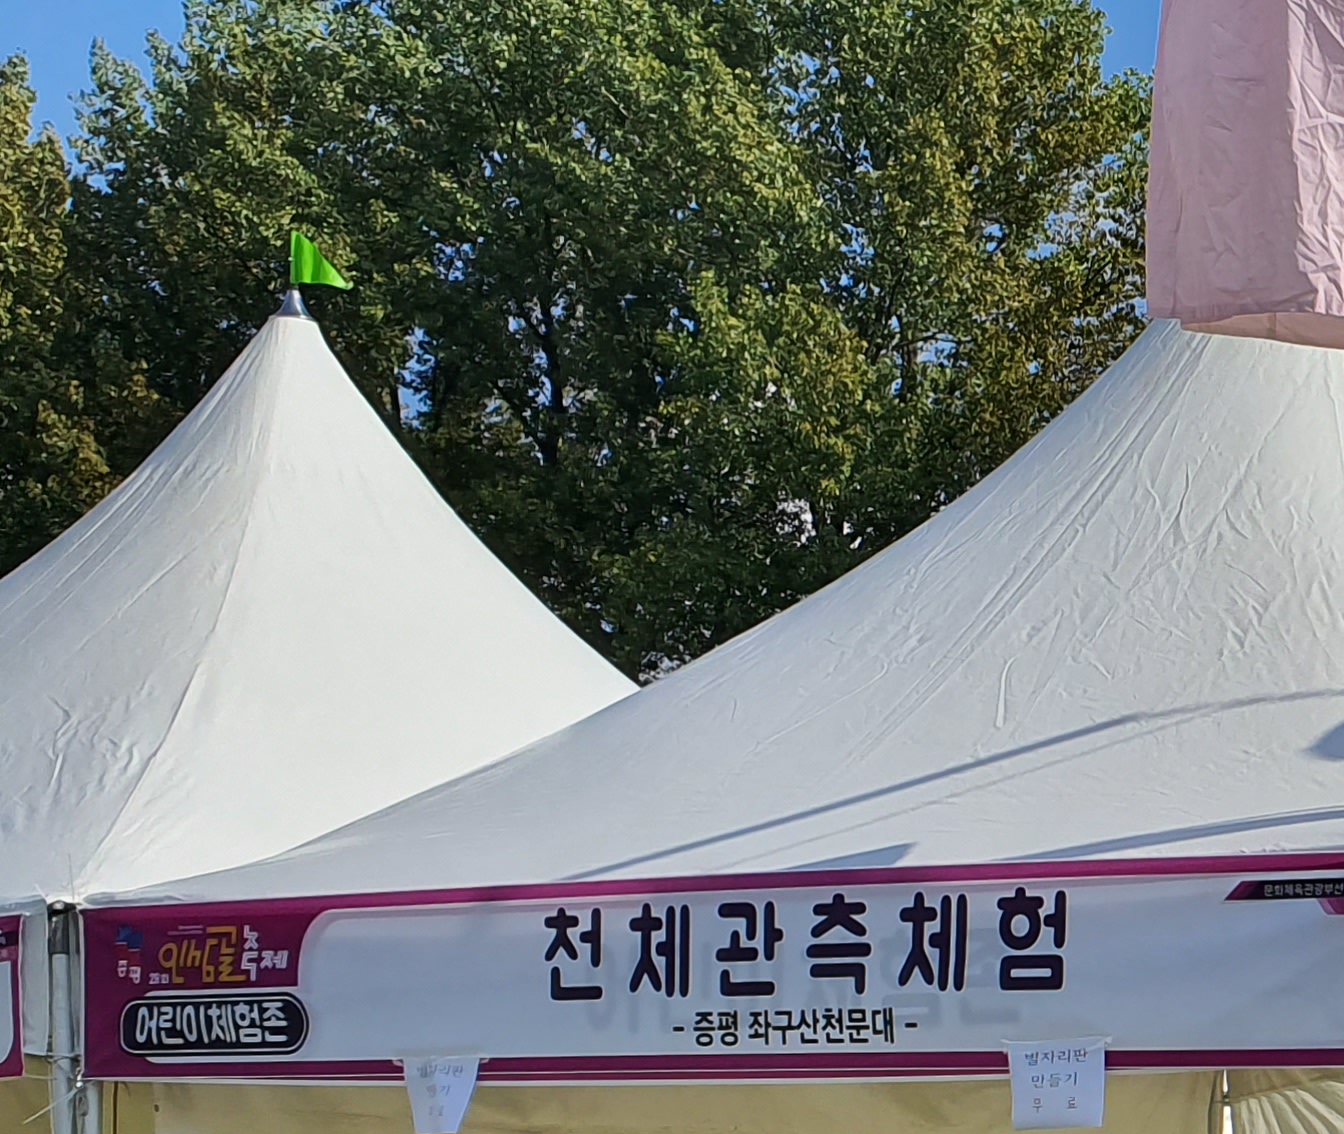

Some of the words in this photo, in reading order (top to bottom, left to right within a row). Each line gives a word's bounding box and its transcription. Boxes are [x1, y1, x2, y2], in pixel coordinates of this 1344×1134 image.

[543, 886, 1068, 1001] 천체관측체험
[135, 1002, 289, 1045] 어린이체험존
[693, 1010, 739, 1047] 증평
[748, 1006, 895, 1046] 좌구산천문대
[1031, 1071, 1078, 1089] 만들기
